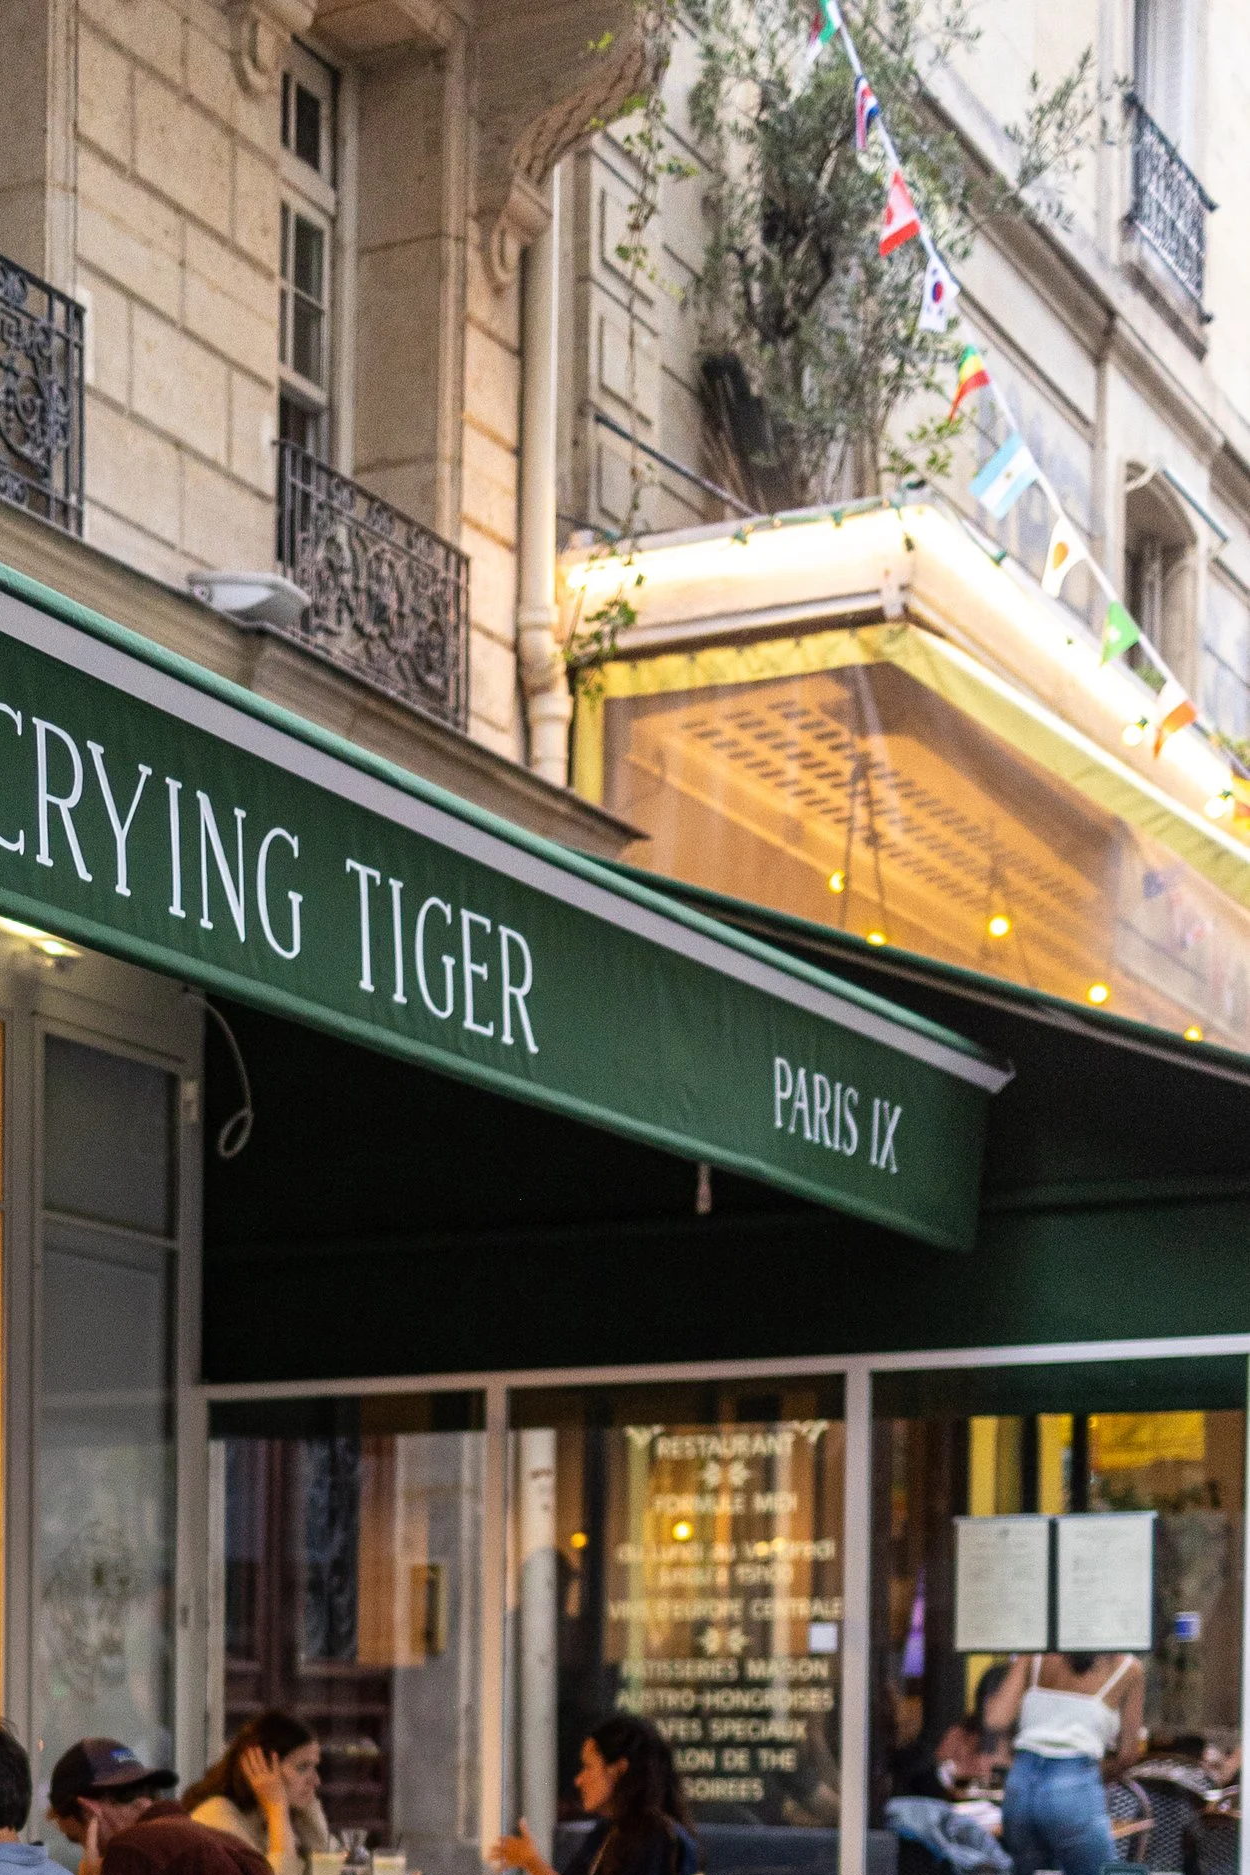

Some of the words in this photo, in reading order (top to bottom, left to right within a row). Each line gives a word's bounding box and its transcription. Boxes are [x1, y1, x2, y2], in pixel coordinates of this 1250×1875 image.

[345, 858, 540, 1055] TIGER
[773, 1056, 859, 1157] PARIS
[869, 1097, 903, 1175] IX
[656, 1433, 794, 1459] RESTAURANT
[722, 1749, 749, 1771] DE
